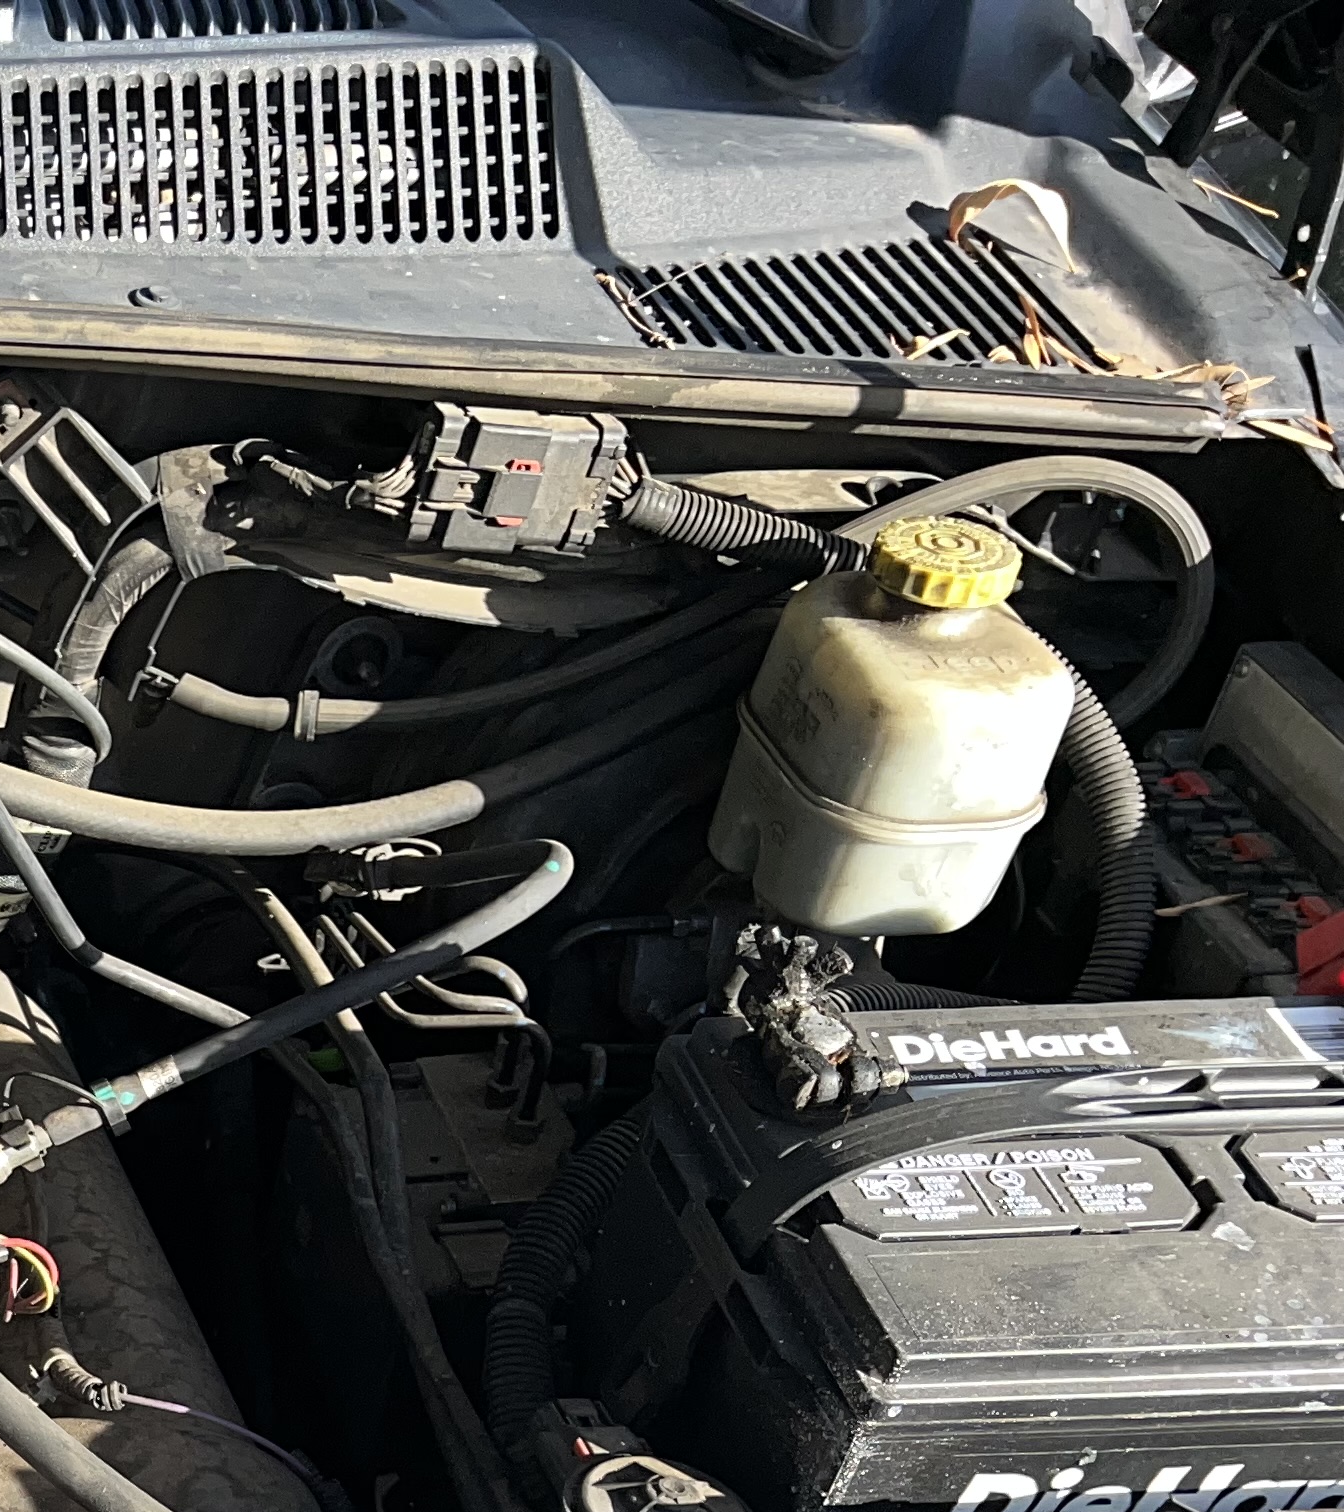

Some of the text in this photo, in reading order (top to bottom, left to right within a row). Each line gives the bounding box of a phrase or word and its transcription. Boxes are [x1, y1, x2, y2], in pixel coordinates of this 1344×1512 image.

[888, 1026, 1132, 1065] DieHard
[900, 1152, 989, 1170] DANGER
[1009, 1147, 1095, 1164] POISON
